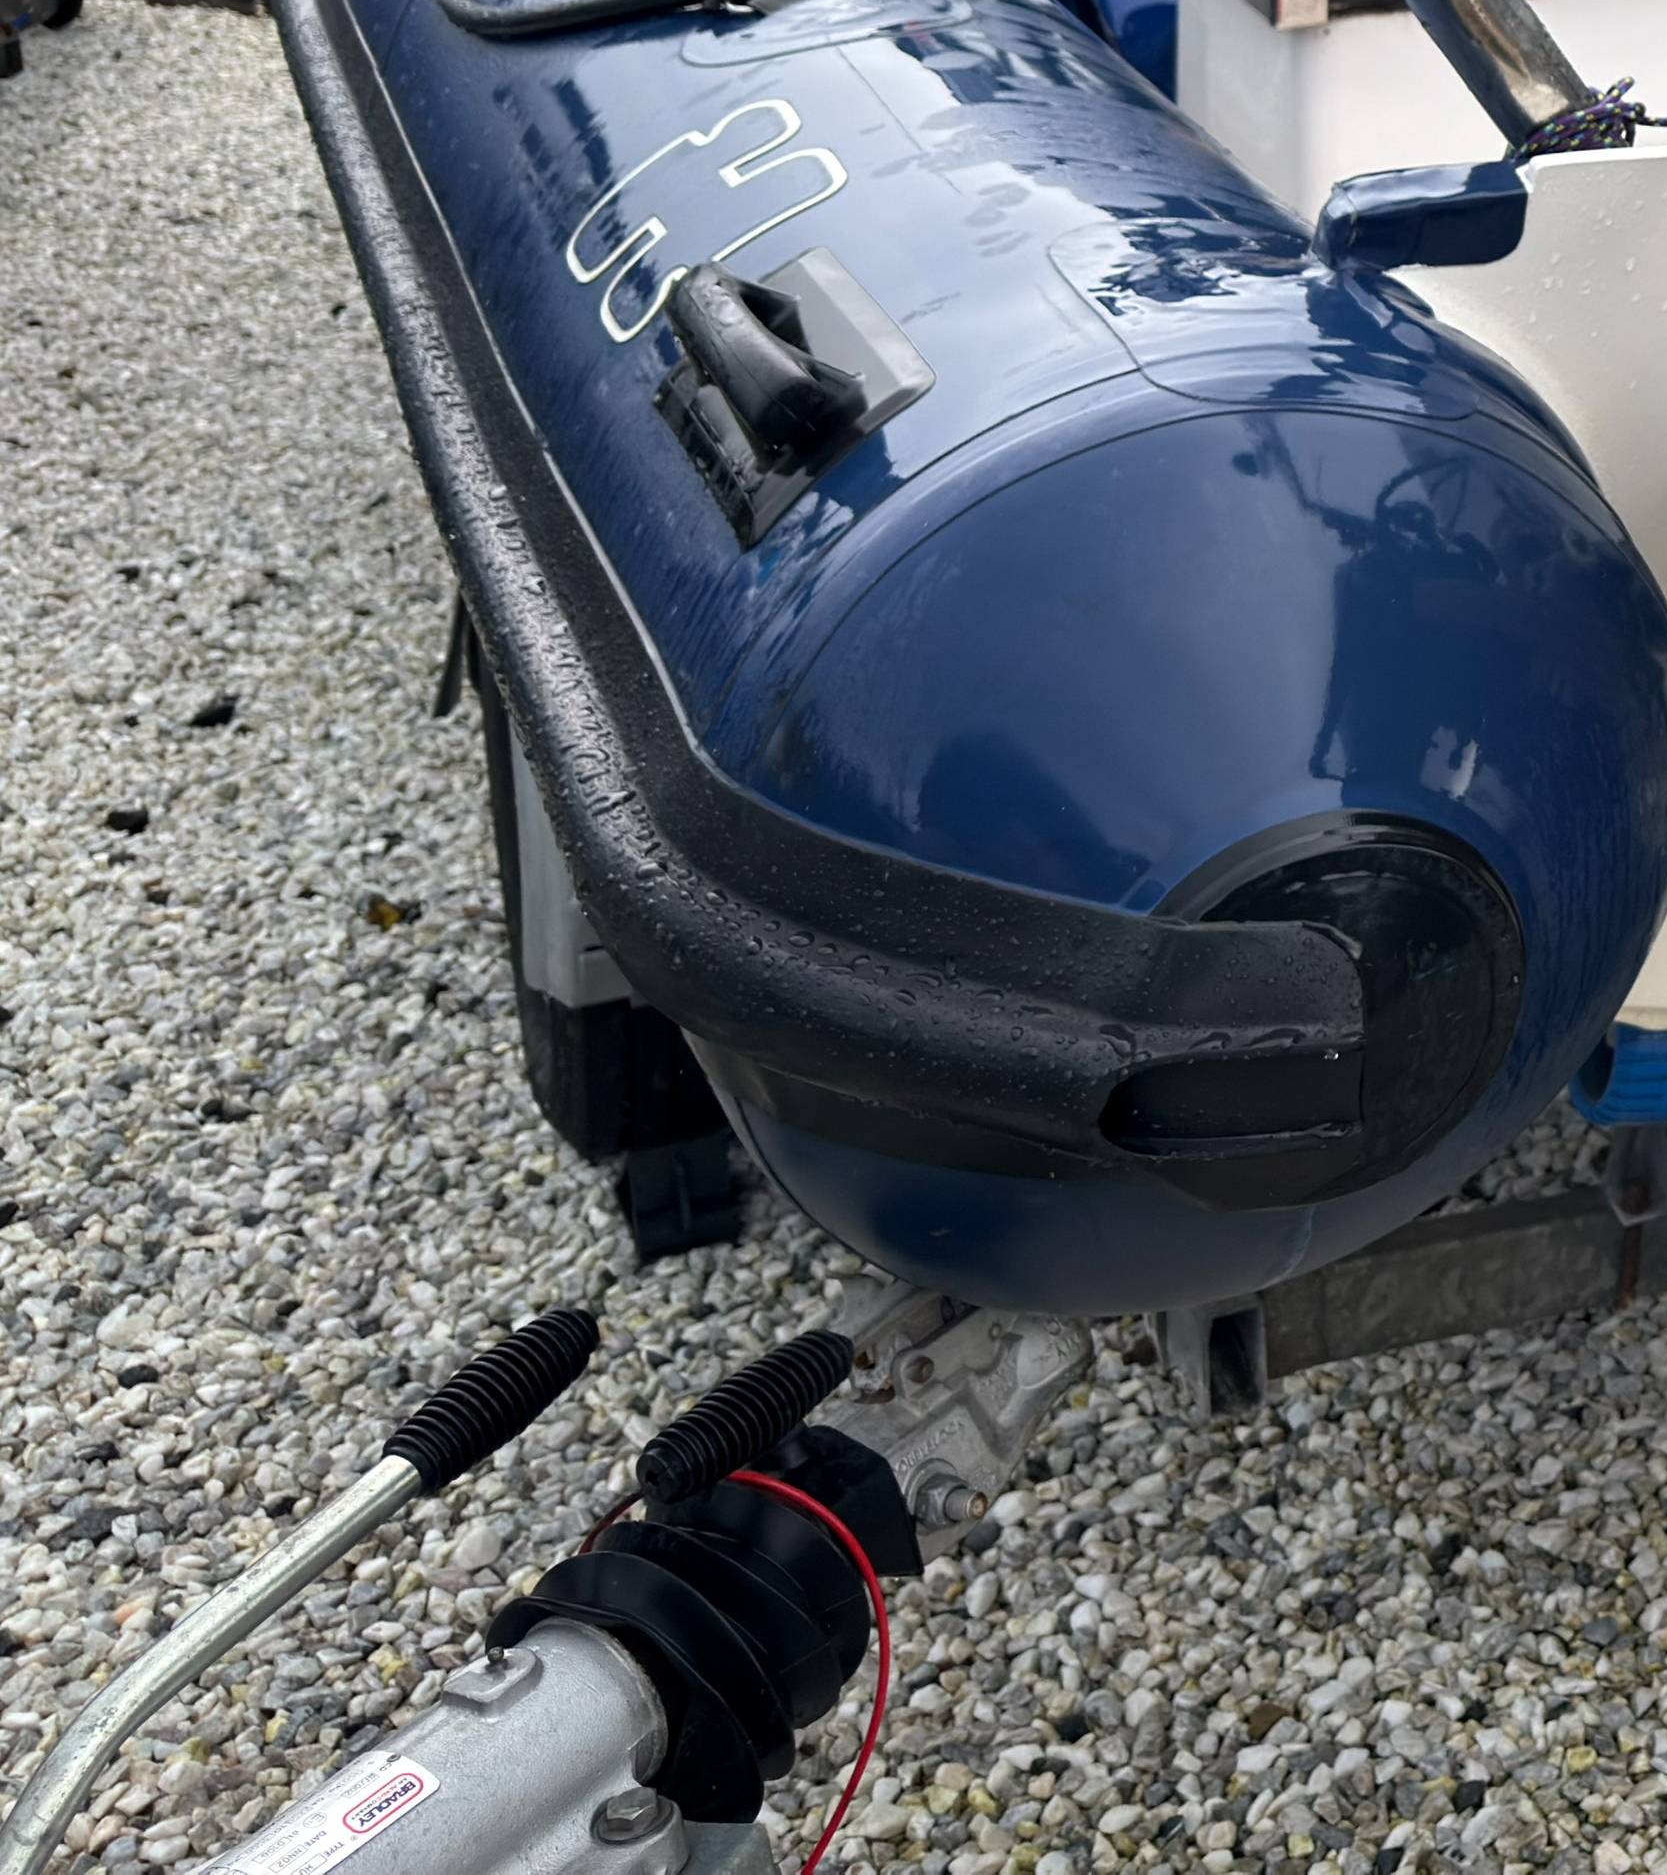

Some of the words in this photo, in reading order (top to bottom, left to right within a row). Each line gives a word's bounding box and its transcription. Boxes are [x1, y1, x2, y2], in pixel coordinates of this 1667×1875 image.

[358, 1780, 416, 1827] BRADLEY
[305, 1830, 327, 1847] DATE
[324, 1841, 345, 1858] TYPE
